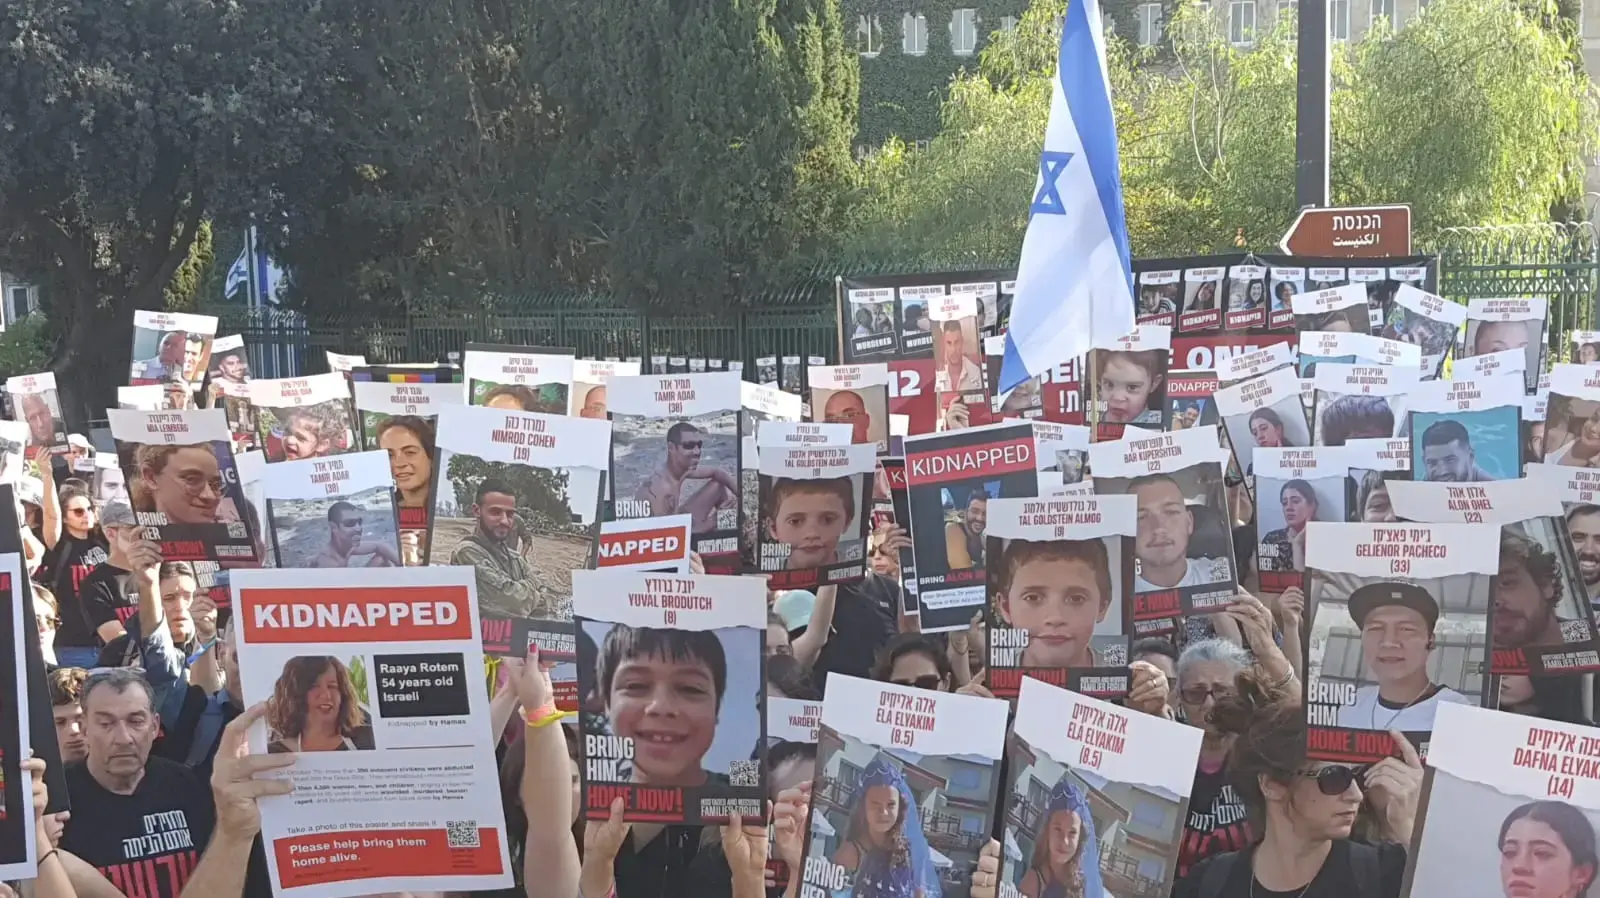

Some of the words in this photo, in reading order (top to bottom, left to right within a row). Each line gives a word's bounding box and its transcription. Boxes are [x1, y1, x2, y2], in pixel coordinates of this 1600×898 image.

[1332, 214, 1381, 231] הכנסת
[1332, 233, 1380, 248] الكنيست
[1183, 313, 1217, 326] KIDNAPPED
[1230, 312, 1262, 324] KIDNAPPED
[1272, 313, 1295, 323] KIDNAPP
[906, 335, 933, 348] MURDE
[1167, 380, 1219, 393] IDNAPPE
[654, 391, 676, 402] TAMIR
[677, 390, 696, 401] ADAR
[1457, 391, 1481, 400] BERMAN
[668, 402, 683, 413] (38)
[505, 416, 520, 430] כהן
[522, 417, 546, 431] נמרוד
[491, 429, 526, 445] NIMROD
[527, 433, 556, 448] COHEN
[1130, 437, 1163, 450] קופרשטיין
[1163, 435, 1173, 445] בר
[513, 447, 530, 462] (19)
[911, 444, 1030, 477] KIDNAPPED
[1124, 453, 1138, 464] BAR
[1138, 445, 1182, 461] KUPERSHTEIN
[1147, 461, 1161, 472] (22)
[310, 473, 331, 484] TAMIR
[333, 470, 350, 482] ADAR
[325, 483, 340, 494] (38)
[1447, 487, 1465, 498] אהל
[1467, 487, 1486, 499] אלון
[1568, 481, 1579, 490] TAL
[615, 500, 650, 517] BRING
[1024, 503, 1045, 514] אלמוג
[1047, 501, 1085, 514] גולדשטיין
[1087, 500, 1097, 510] טל
[1448, 499, 1470, 510] ALON
[1471, 499, 1494, 510] OHEL
[136, 512, 168, 526] BRING
[1019, 515, 1033, 526] TAL
[1033, 514, 1073, 525] GOLDSTEIN
[1075, 513, 1101, 524] ALMOG
[1464, 512, 1483, 523] (22)
[1410, 529, 1431, 542] ג'ימי
[597, 535, 679, 558] NAPPED
[761, 543, 791, 556] BRING
[1258, 544, 1279, 557] BRING
[1356, 544, 1400, 557] GELIENOR
[1402, 545, 1446, 558] PACHECO
[1390, 560, 1410, 574] (33)
[645, 578, 673, 594] ברודץ
[676, 579, 695, 592] יובל
[920, 576, 945, 585] BRING
[628, 594, 660, 608] YUVAL
[662, 595, 712, 610] BRODUTCH
[254, 602, 458, 628] KIDNAPPED
[664, 610, 677, 625] (8)
[990, 628, 1029, 648] BRING
[990, 648, 1015, 667] HIM
[1493, 648, 1527, 667] OW!
[1543, 658, 1574, 669] FAMILIES
[380, 664, 417, 675] Raaya
[420, 662, 459, 672] Rotem
[382, 678, 396, 688] 54
[398, 679, 431, 690] years
[435, 676, 453, 686] old
[383, 691, 420, 702] Israeli
[880, 691, 913, 711] אליקים
[1308, 684, 1356, 705] BRING
[916, 696, 936, 714] אלה
[788, 716, 816, 728] YARDEN
[876, 708, 892, 724] ELA
[895, 711, 935, 732] ELYAKIM
[1071, 703, 1105, 727] אליקים
[1308, 705, 1338, 726] HIM
[1106, 714, 1129, 734] אלה
[891, 729, 914, 747] (8.5)
[1067, 721, 1083, 739] ELA
[1085, 726, 1125, 754] ELYAKIM
[1308, 729, 1349, 751] HOME
[1355, 732, 1394, 755] NOW
[1527, 727, 1576, 753] אליקים
[586, 734, 634, 758] BRING
[1578, 736, 1600, 757] פנה
[1079, 744, 1102, 769] (8.5)
[1513, 747, 1557, 772] DAFNA
[1561, 755, 1600, 780] ELYAK
[586, 758, 617, 782] HIM
[1547, 775, 1574, 799] (14)
[587, 785, 632, 808] HOME
[636, 787, 684, 811] NOW!
[701, 806, 733, 816] FAMILIES
[735, 806, 760, 816] FORUM
[143, 809, 188, 834] מחזירים
[287, 826, 305, 834] Take
[315, 823, 337, 831] photo
[122, 833, 164, 859] הביתה
[163, 828, 194, 851] אותם
[289, 841, 331, 854] Please
[333, 839, 359, 850] help
[362, 838, 394, 848] bring
[397, 837, 427, 846] them
[292, 856, 327, 868] home
[330, 852, 361, 863] alive.
[97, 850, 197, 898] עכשי
[803, 856, 845, 890] BRING
